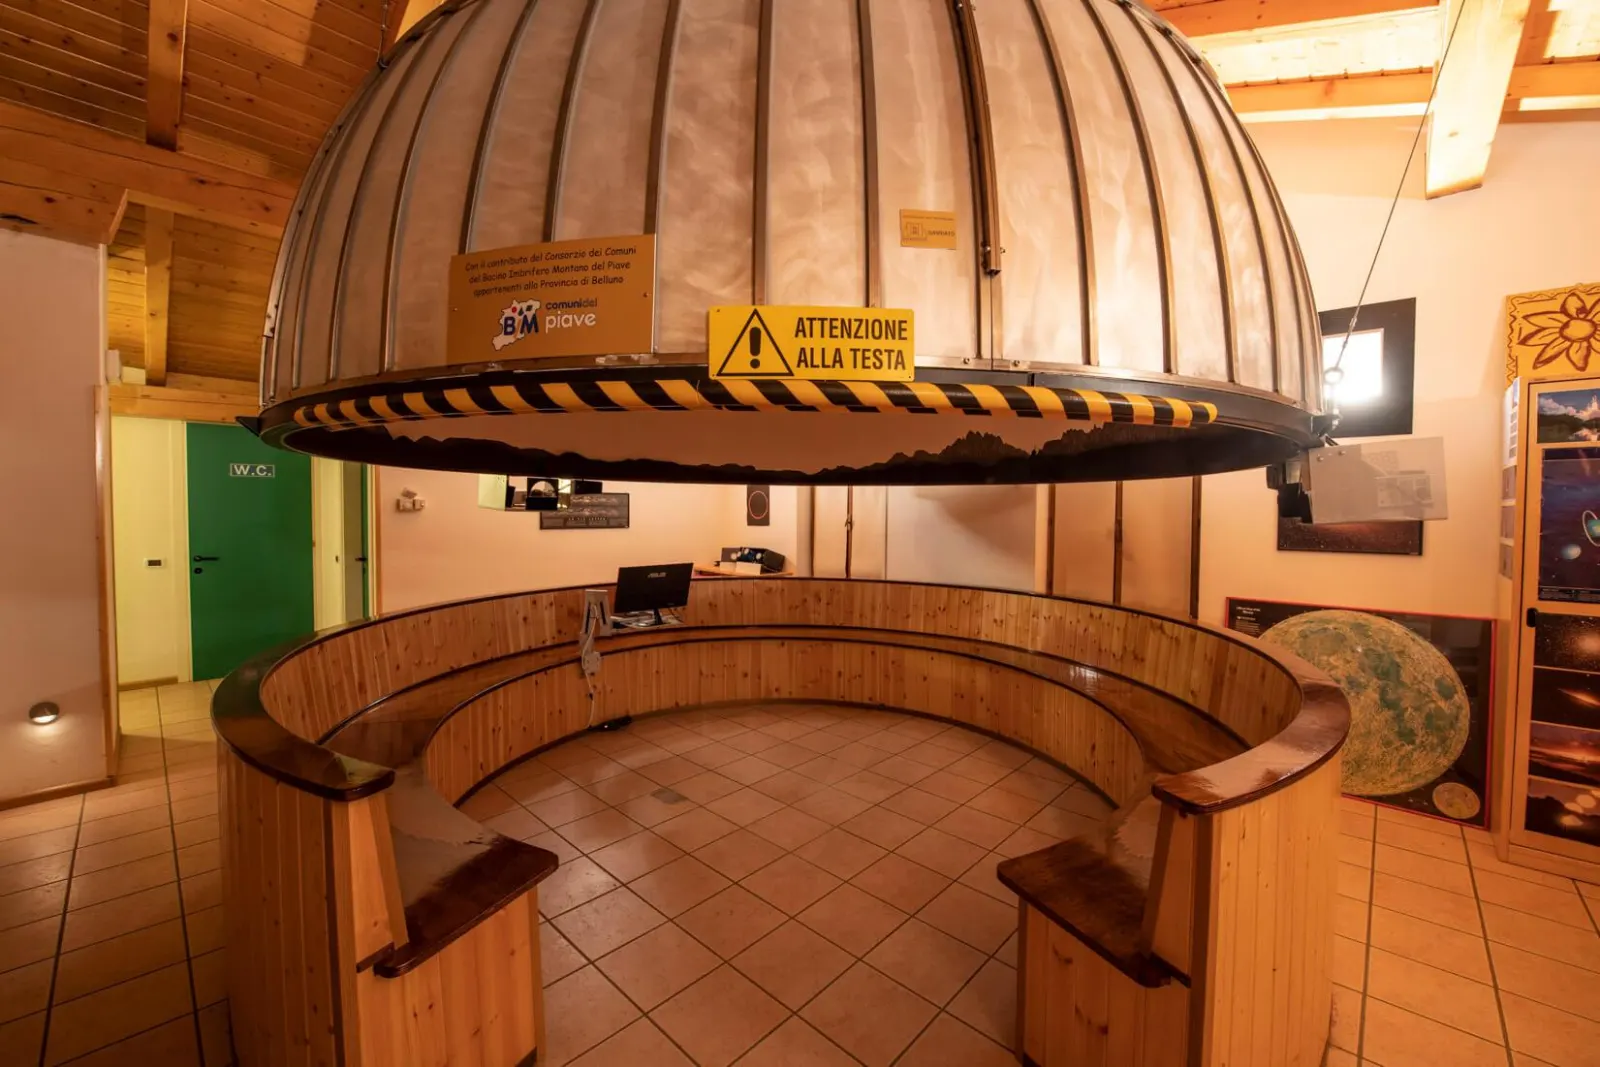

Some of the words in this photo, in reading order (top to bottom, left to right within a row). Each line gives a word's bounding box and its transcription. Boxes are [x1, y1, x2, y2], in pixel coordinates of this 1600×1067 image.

[465, 262, 479, 271] Con
[480, 260, 486, 268] il
[487, 256, 528, 268] contributo
[530, 253, 543, 262] del
[545, 250, 586, 261] Consorzio
[605, 246, 637, 256] Comuni
[469, 275, 480, 284] del
[482, 272, 507, 282] Bacino
[508, 267, 550, 278] Imbrifero
[552, 265, 589, 274] Montano
[592, 262, 605, 271] del
[607, 261, 631, 270] Piave
[474, 284, 522, 298] appartenenti
[524, 281, 538, 290] alla
[541, 277, 578, 288] Provincia
[580, 276, 589, 286] di
[592, 275, 624, 285] Belluno
[545, 311, 596, 334] piave
[795, 317, 908, 341] ATTENZIONE
[796, 347, 844, 369] ALLA
[849, 348, 906, 370] TESTA
[233, 464, 272, 476] W.C.
